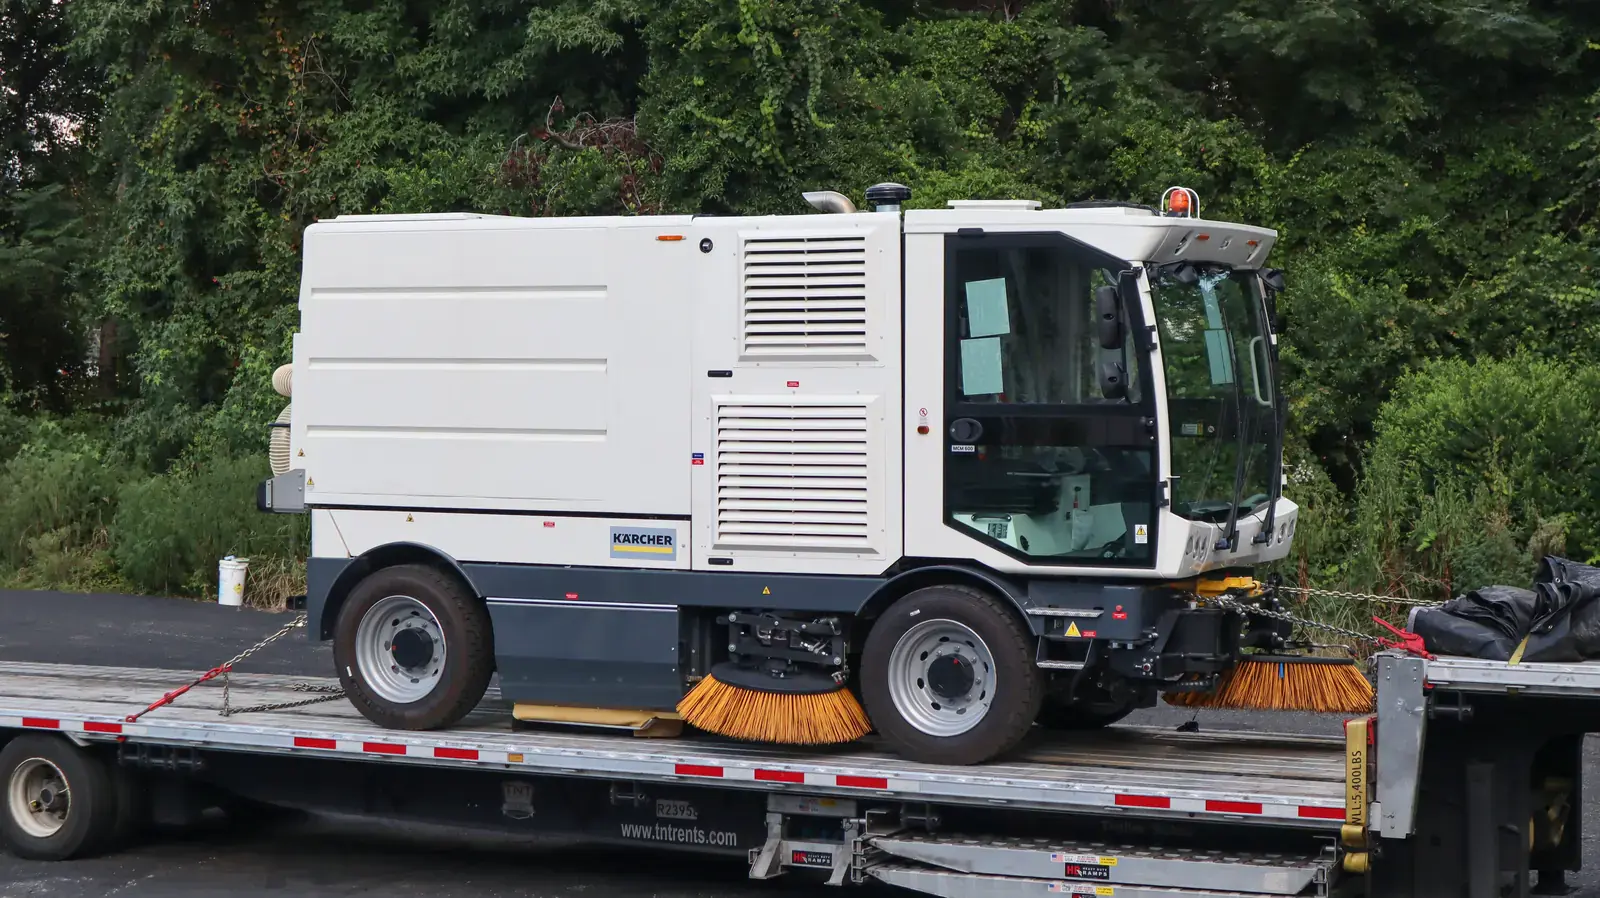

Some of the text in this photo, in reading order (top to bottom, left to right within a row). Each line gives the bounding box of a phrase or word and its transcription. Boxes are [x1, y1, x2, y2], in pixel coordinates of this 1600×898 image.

[613, 533, 673, 546] KÄRCHER
[506, 784, 531, 796] TNT
[621, 822, 738, 847] www.tntrents.com
